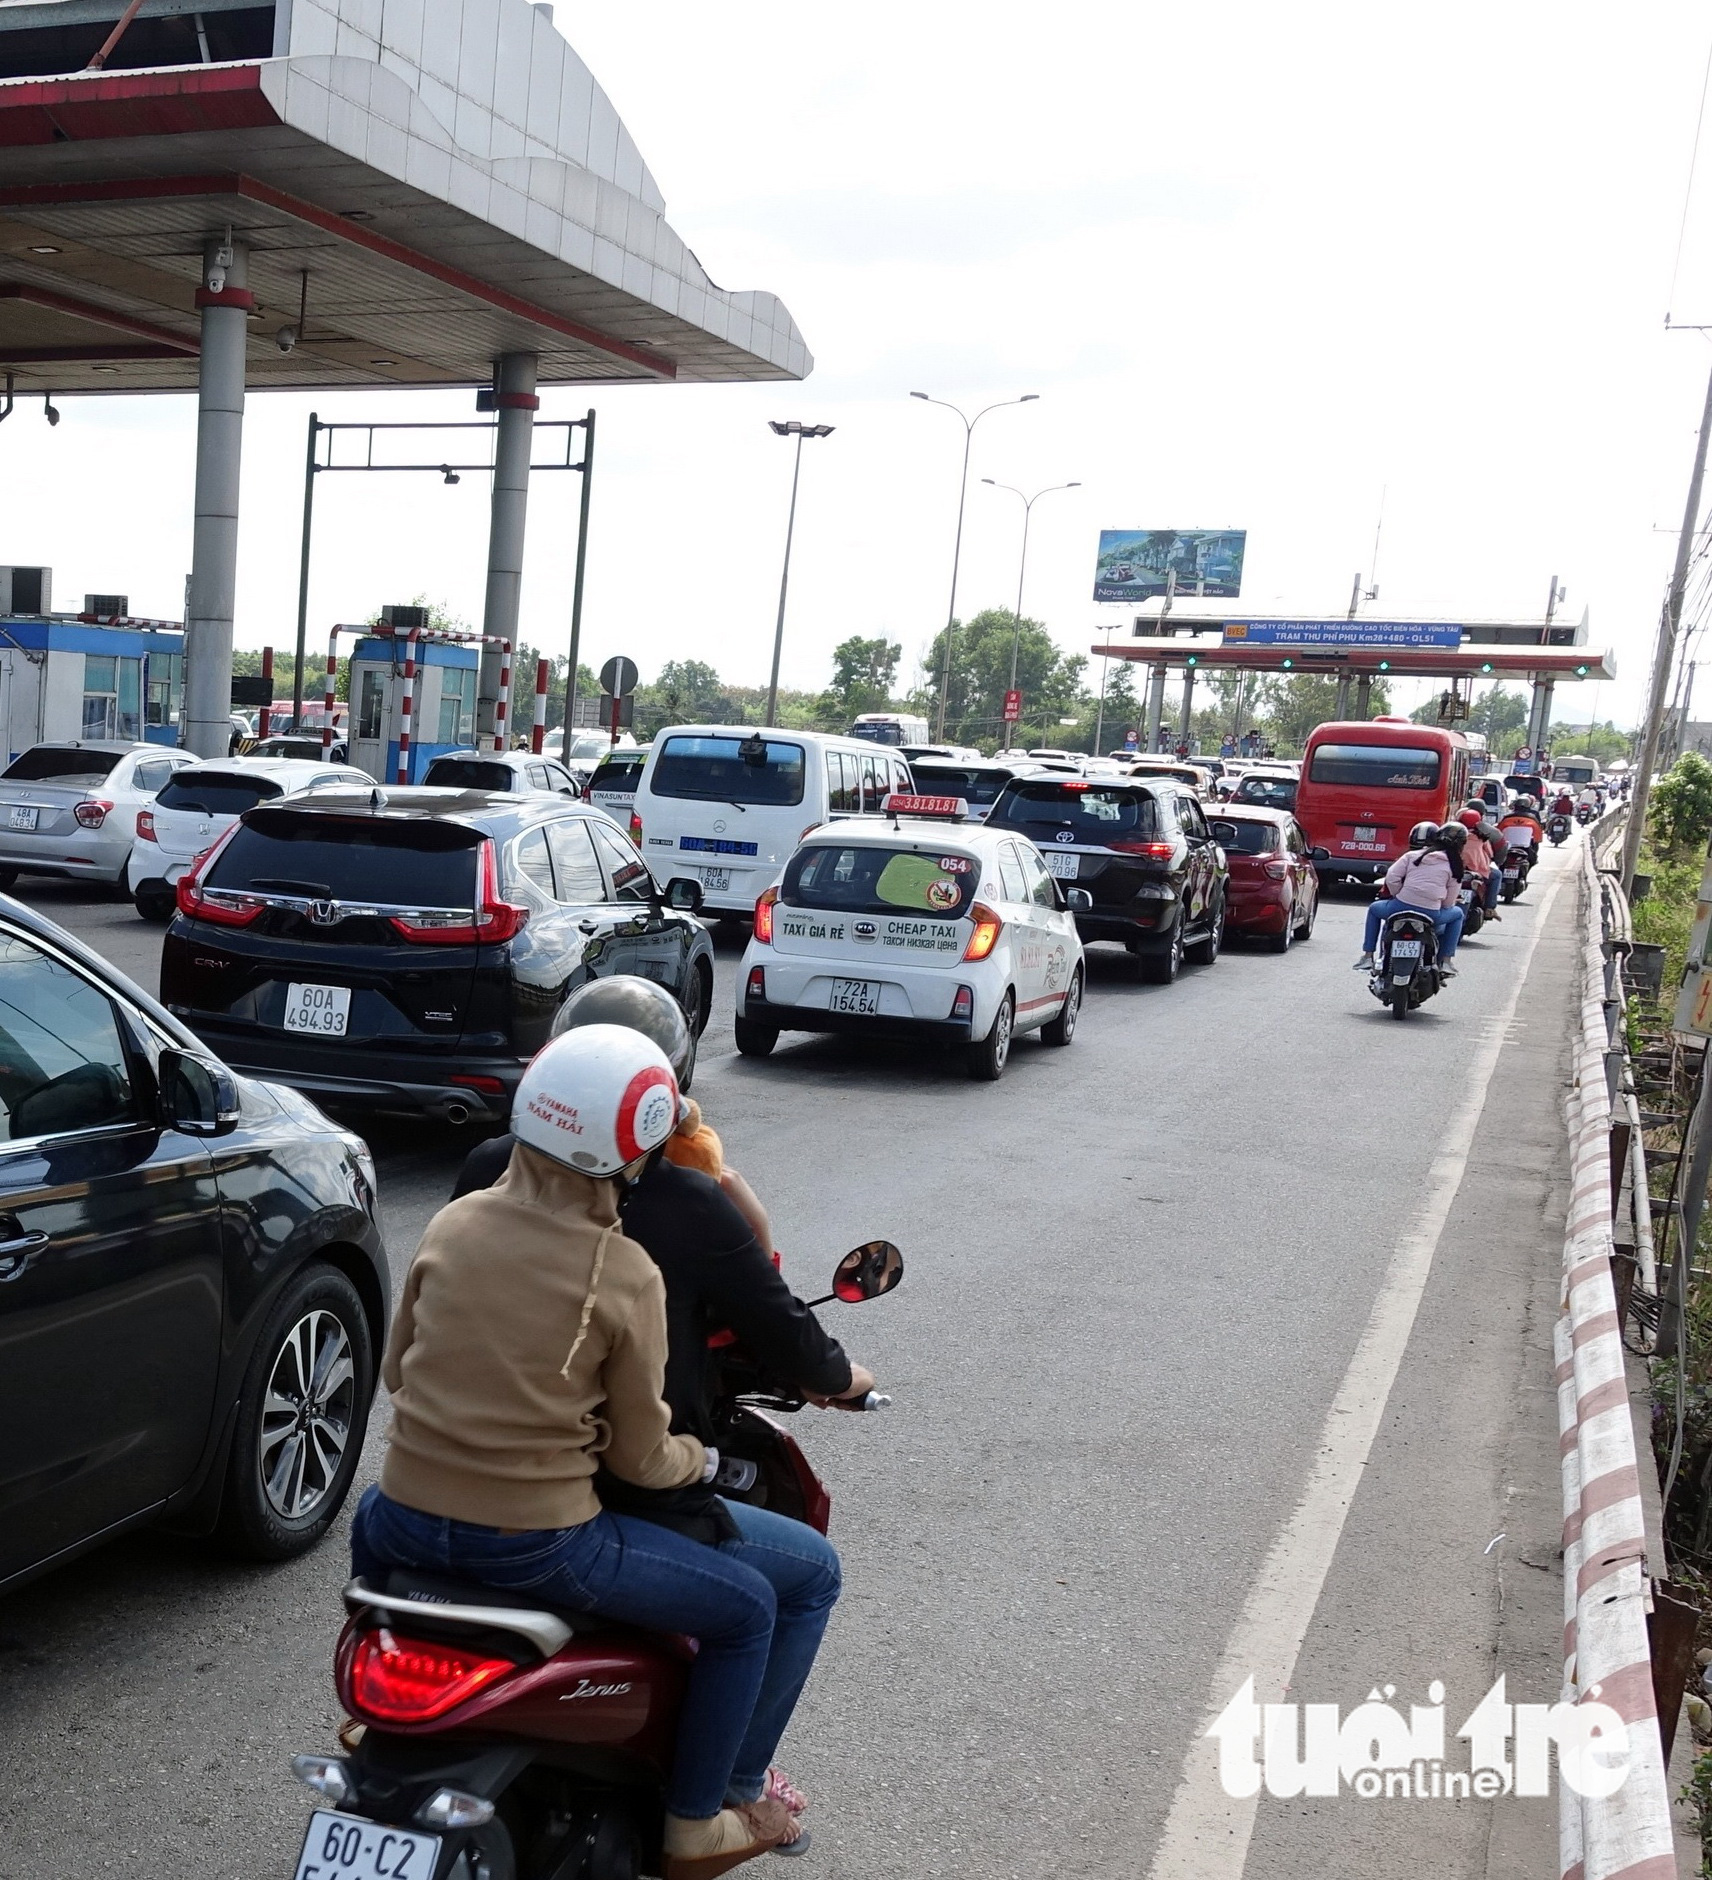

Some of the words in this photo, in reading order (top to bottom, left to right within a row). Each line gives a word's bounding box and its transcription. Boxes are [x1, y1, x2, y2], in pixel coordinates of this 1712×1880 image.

[1227, 627, 1245, 636] BVEC
[1323, 632, 1337, 641] PHÍ
[940, 857, 967, 872] 054
[1053, 855, 1071, 866] 51G
[707, 867, 723, 878] 60A
[809, 923, 826, 938] GIÁ
[830, 923, 845, 940] RẺ
[888, 922, 927, 935] CHEAP
[931, 925, 956, 938] TAXI
[883, 936, 905, 947] такси
[937, 940, 958, 952] цена
[194, 957, 230, 968] CR-V
[844, 981, 867, 997] 72A
[302, 988, 334, 1010] 60A
[833, 995, 874, 1013] 154.54
[287, 1008, 344, 1032] 494.93
[527, 1101, 553, 1123] NAM
[546, 1096, 579, 1118] YAMAHA
[559, 1679, 632, 1701] Janus
[322, 1822, 416, 1880] 60-C2
